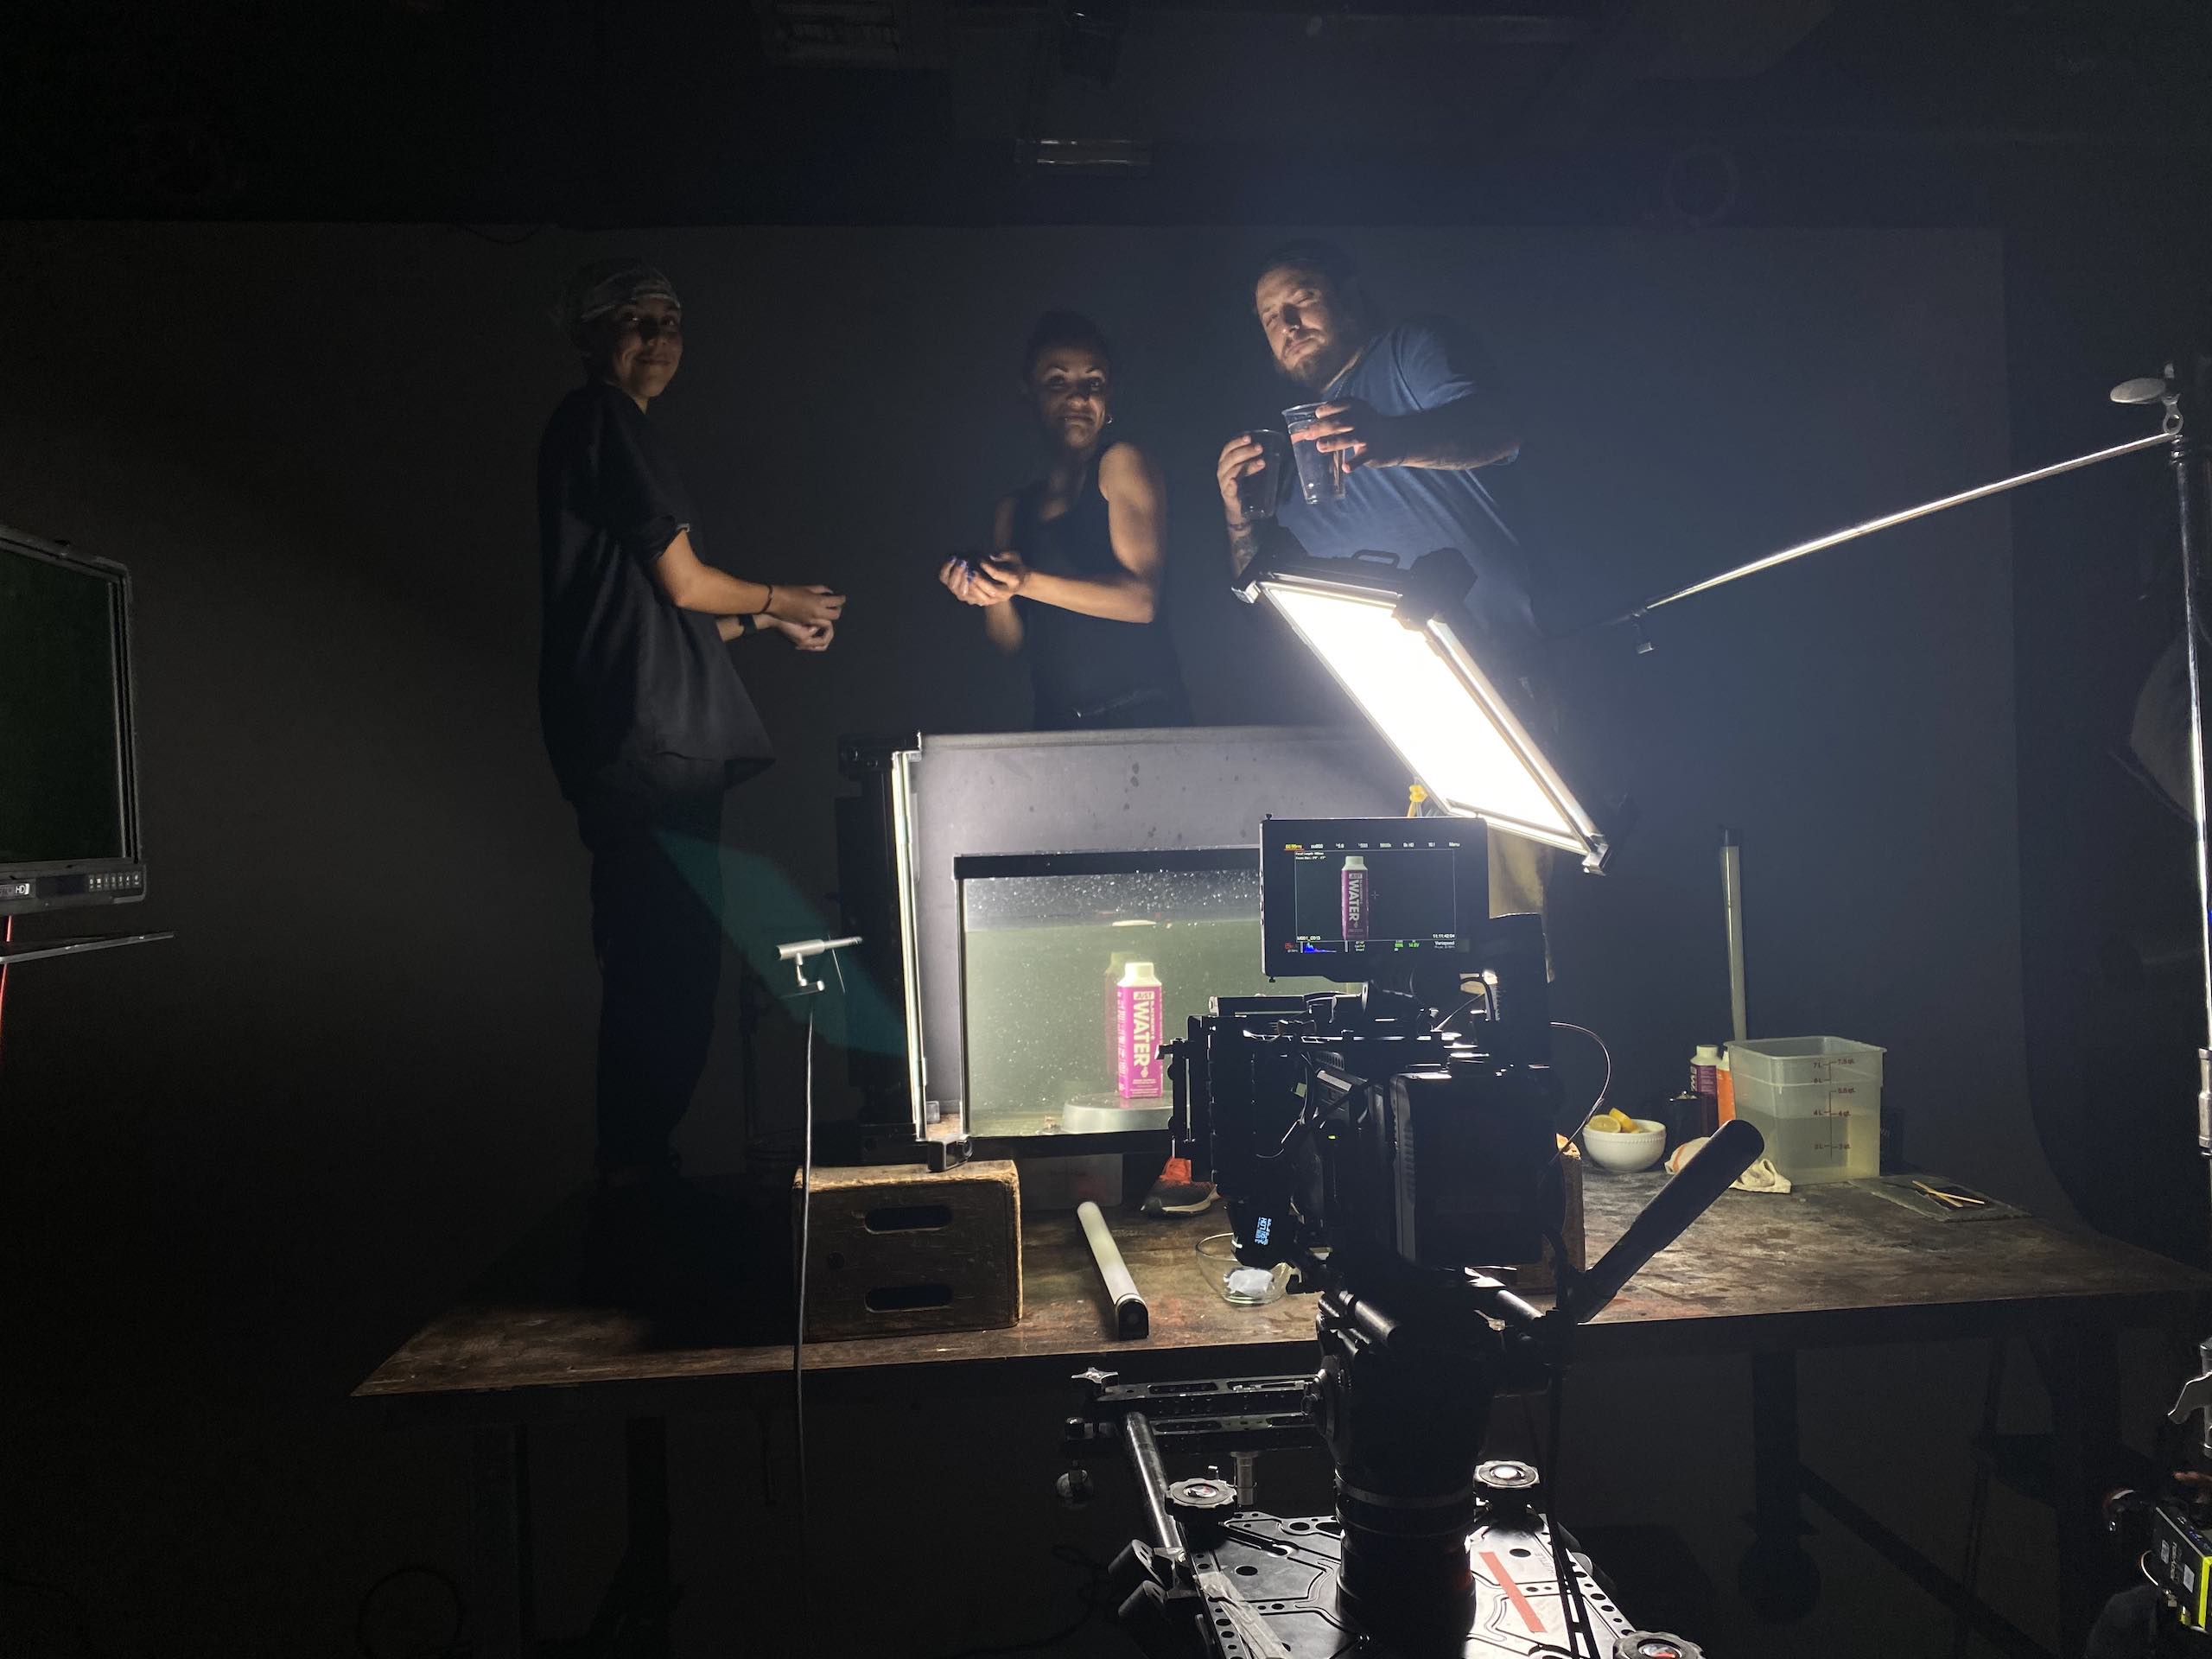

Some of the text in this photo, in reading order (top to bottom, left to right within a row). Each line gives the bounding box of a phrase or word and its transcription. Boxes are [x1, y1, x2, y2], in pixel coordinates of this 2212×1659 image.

[1349, 880, 1360, 921] WATER
[1135, 991, 1154, 1000] JUST
[1134, 1001, 1151, 1066] WATER
